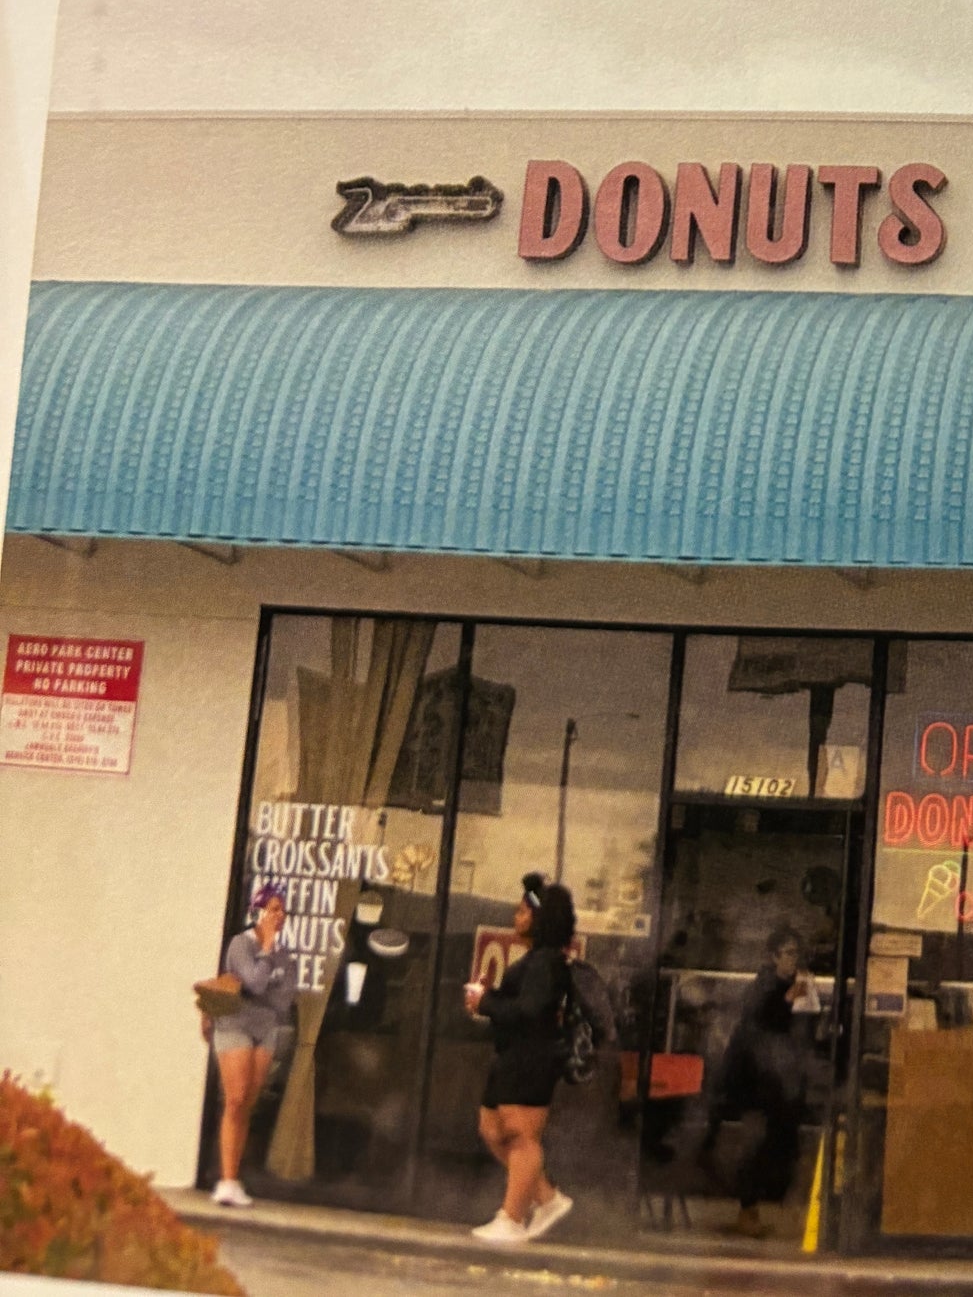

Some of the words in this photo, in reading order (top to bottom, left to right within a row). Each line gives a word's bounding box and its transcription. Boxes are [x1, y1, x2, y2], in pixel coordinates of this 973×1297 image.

[518, 159, 949, 267] DONUTS
[51, 644, 82, 658] PARK
[85, 646, 134, 662] CENTER
[15, 659, 64, 676] PRIVATE
[68, 662, 131, 680] PROPERTY
[33, 677, 51, 691] NO
[53, 678, 107, 695] PARKING
[729, 775, 796, 797] 15102
[256, 800, 355, 841] BUTTER
[252, 836, 390, 882] CROISSANTS
